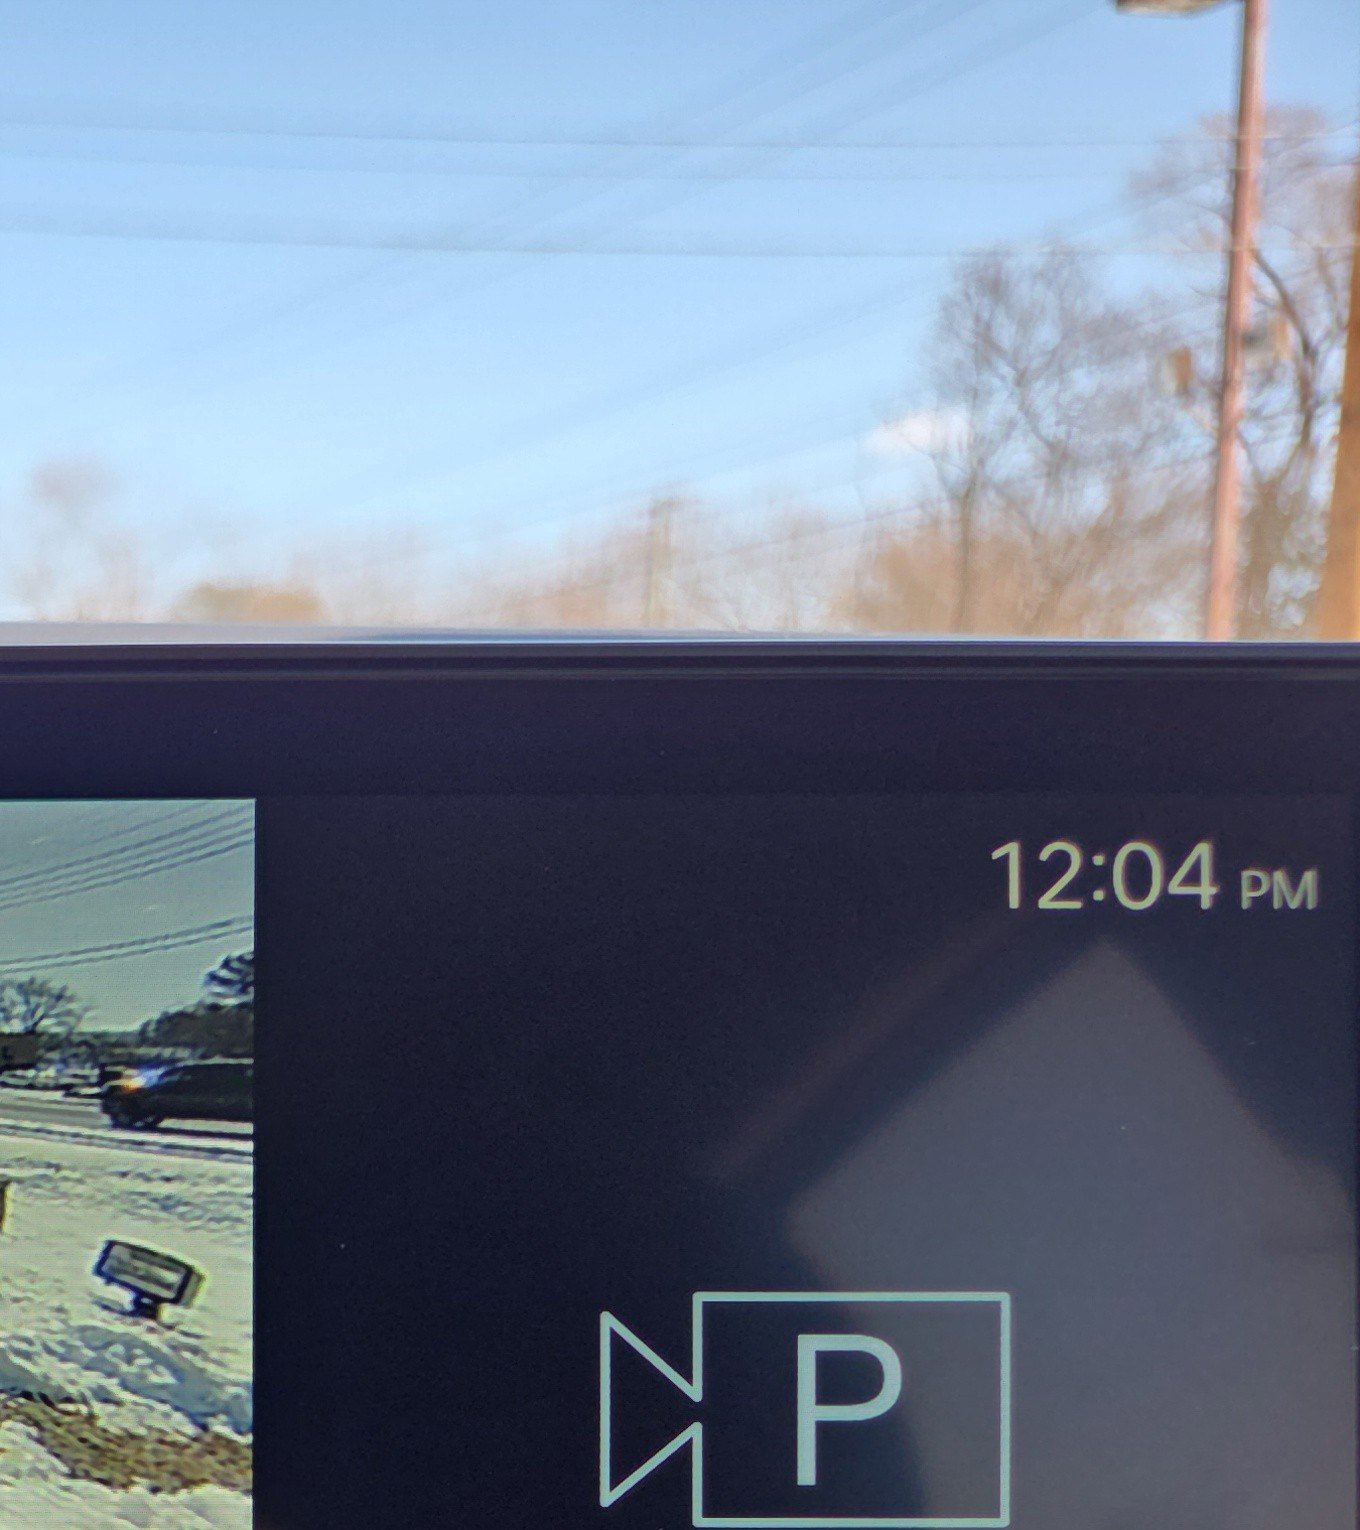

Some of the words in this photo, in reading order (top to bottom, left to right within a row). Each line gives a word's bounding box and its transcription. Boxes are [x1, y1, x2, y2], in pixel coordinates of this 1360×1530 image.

[991, 841, 1221, 910] 12:04
[1240, 869, 1320, 910] PM
[796, 1334, 902, 1487] P
